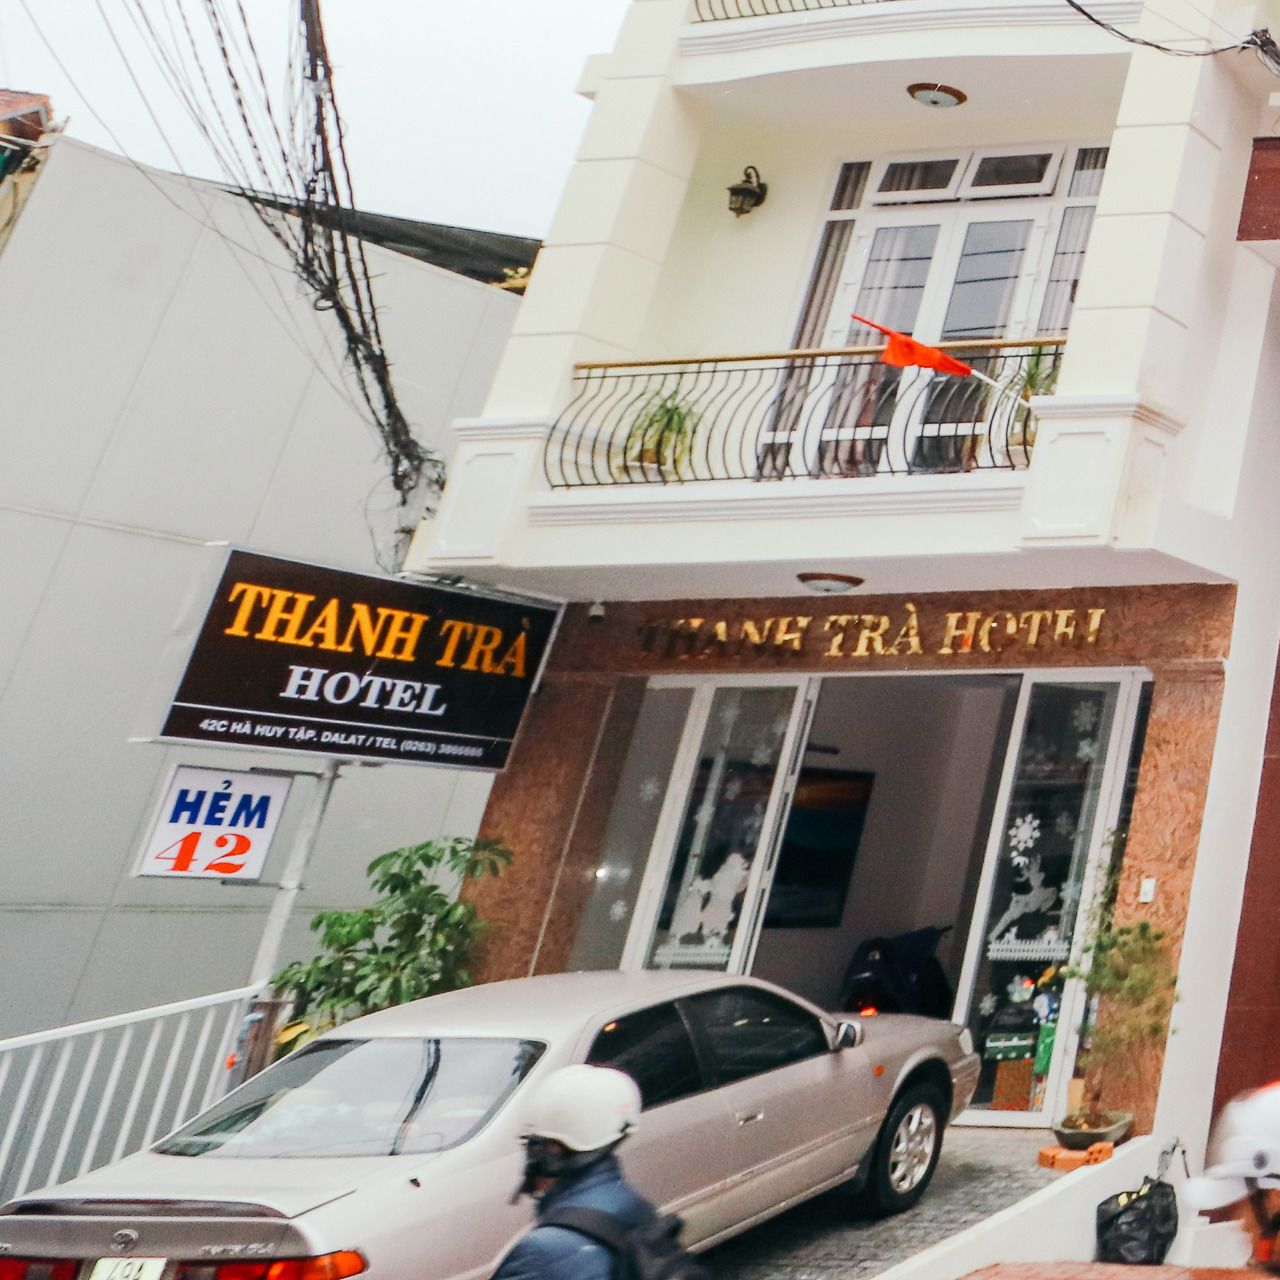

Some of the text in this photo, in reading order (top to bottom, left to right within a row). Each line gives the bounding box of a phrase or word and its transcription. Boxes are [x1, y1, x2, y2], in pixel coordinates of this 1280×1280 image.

[223, 581, 530, 679] THANH TRÀ
[823, 602, 922, 658] TRÀ
[279, 664, 448, 717] HOTEL
[199, 718, 229, 732] 42C
[230, 720, 252, 736] HÀ
[253, 724, 287, 738] HUY
[320, 731, 367, 746] DALAT
[375, 737, 398, 750] TEL
[168, 779, 272, 829] HẺM
[154, 831, 252, 875] 42
